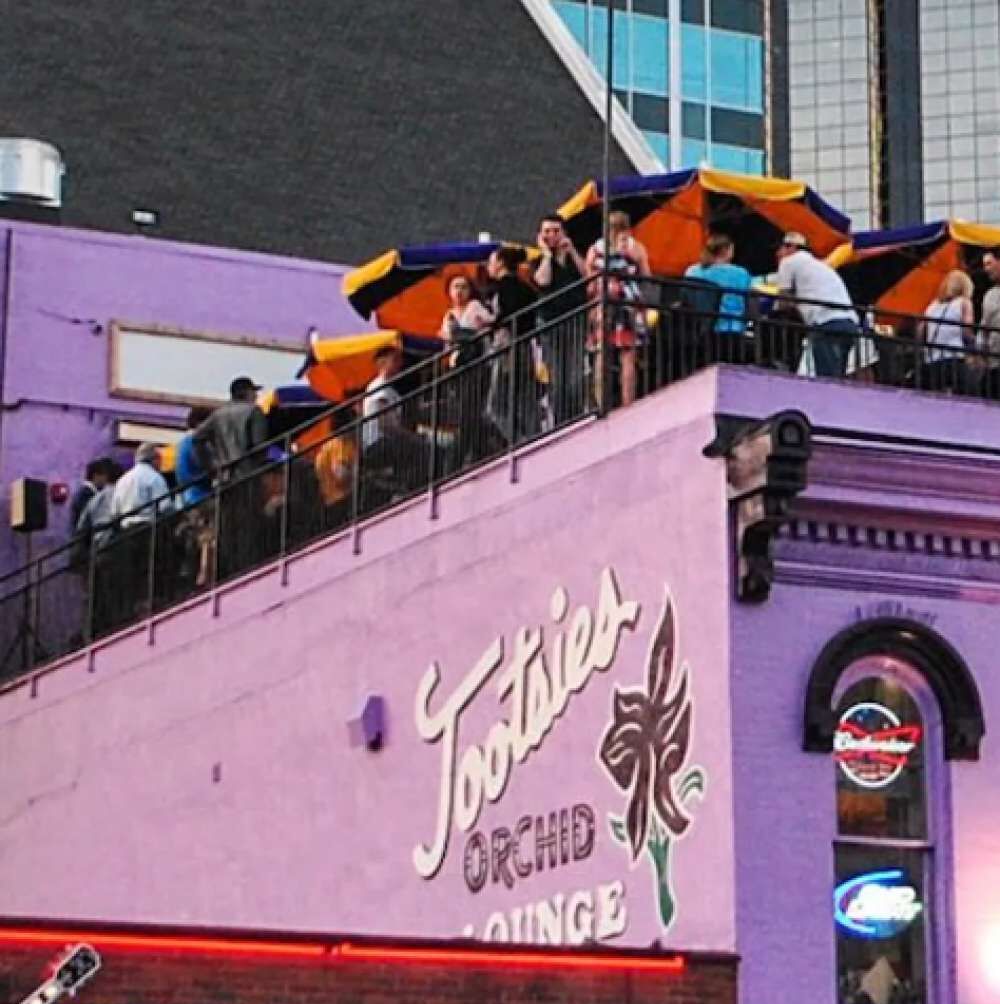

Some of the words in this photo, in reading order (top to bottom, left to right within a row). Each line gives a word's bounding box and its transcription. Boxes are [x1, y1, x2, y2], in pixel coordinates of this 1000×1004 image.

[414, 565, 641, 880] Tootsies
[463, 804, 596, 894] ORCHID
[464, 880, 627, 944] OUNGE
